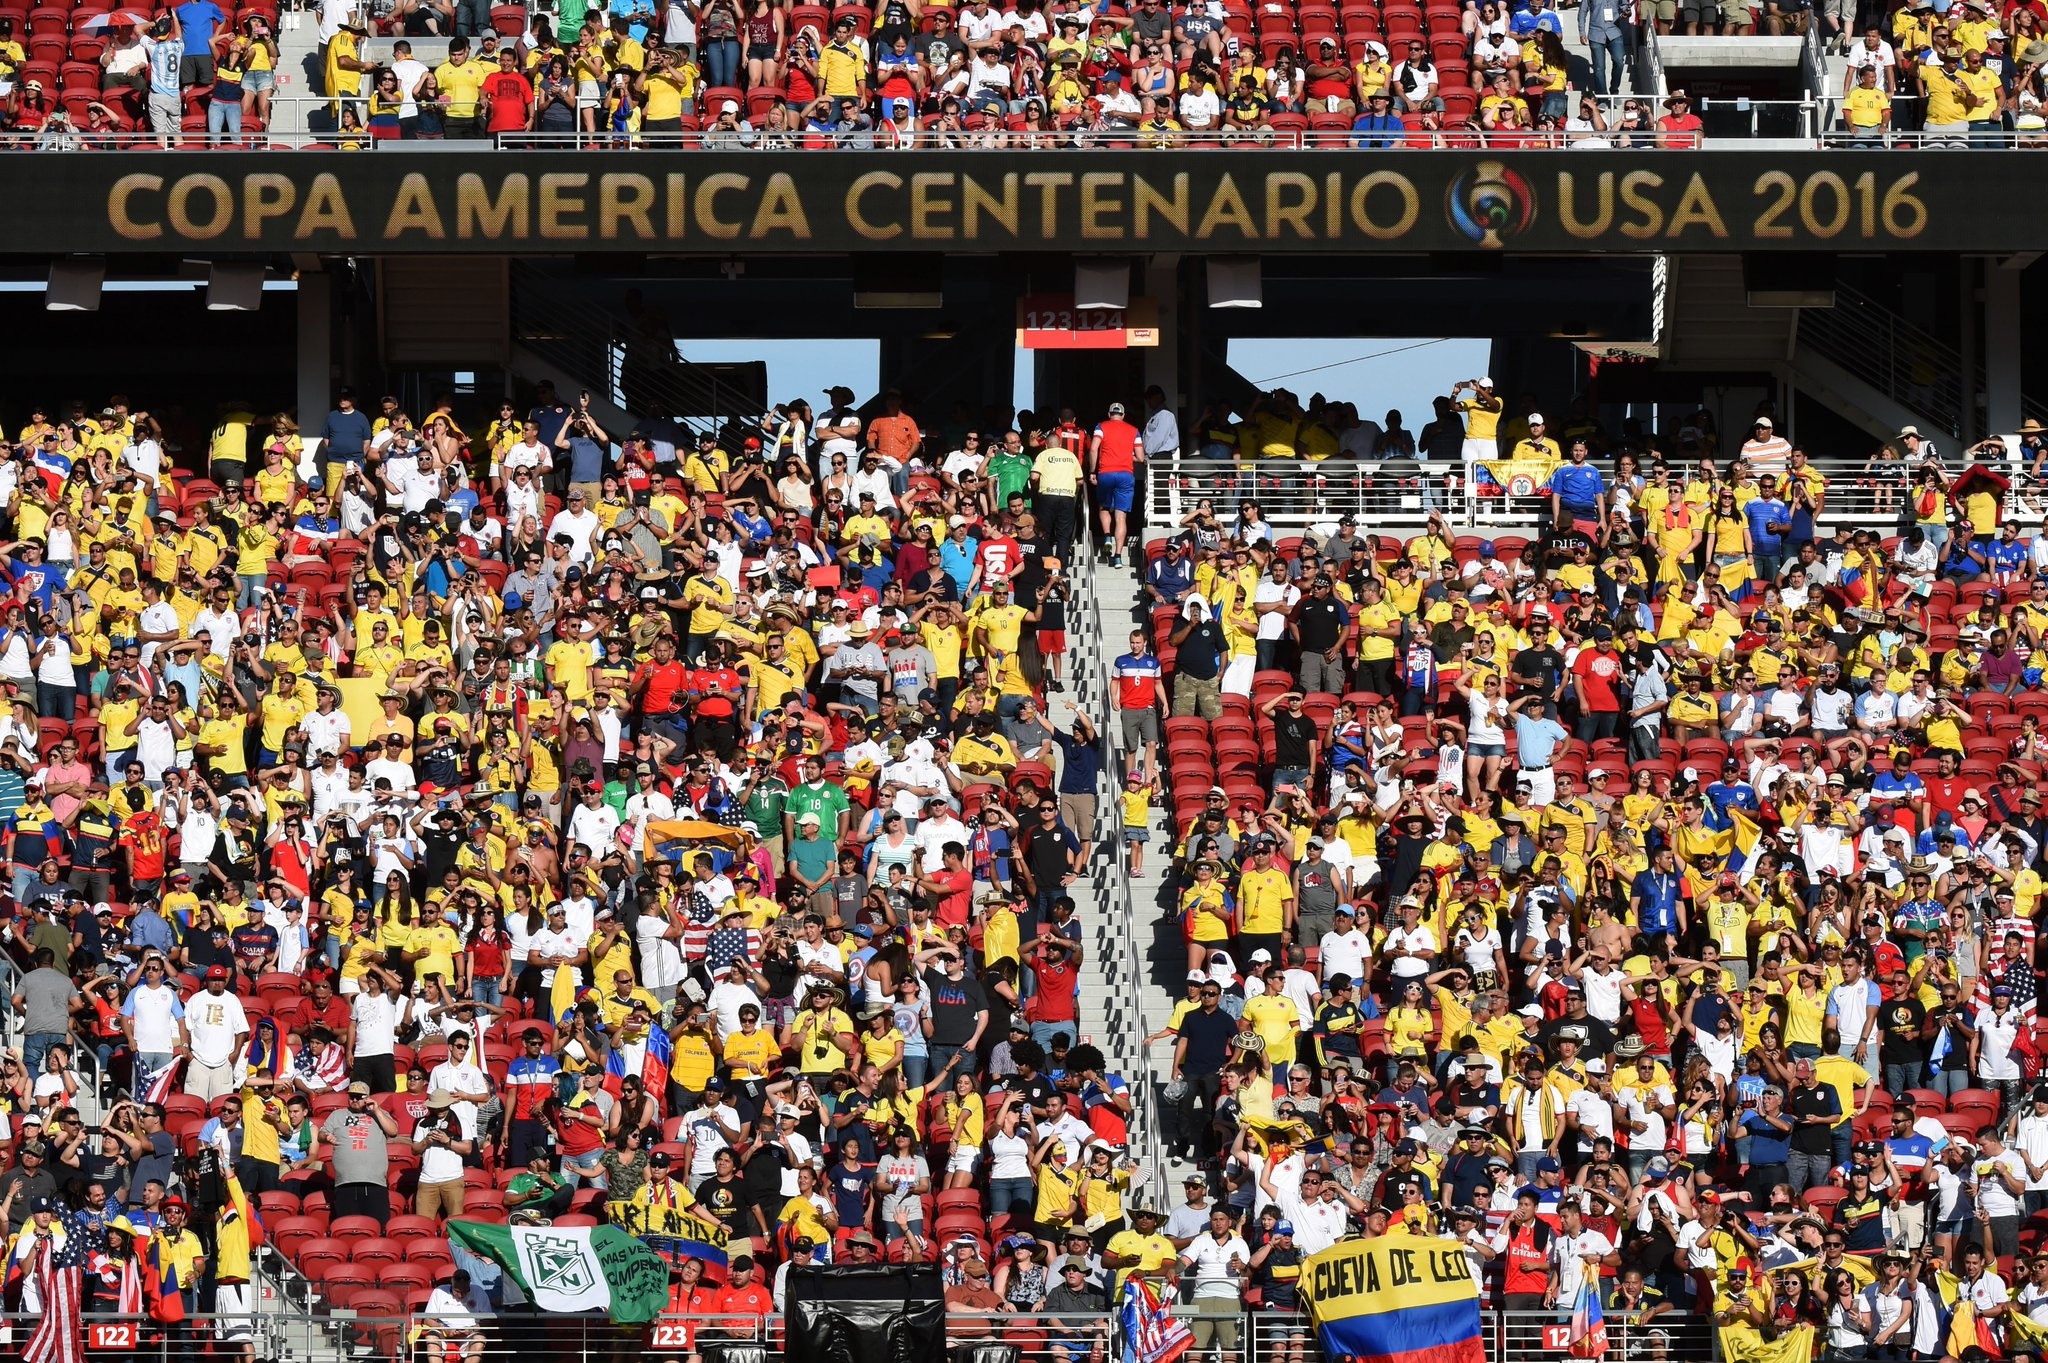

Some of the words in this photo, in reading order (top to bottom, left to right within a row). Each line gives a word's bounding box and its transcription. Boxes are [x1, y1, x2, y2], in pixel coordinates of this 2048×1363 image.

[1186, 20, 1211, 33] USA
[168, 54, 177, 72] 8
[1867, 101, 1874, 109] 10
[107, 172, 357, 240] COPA
[383, 172, 812, 240] AMERICA
[845, 170, 1420, 241] CENTENARIO
[1558, 170, 1729, 240] USA
[1753, 170, 1928, 240] 2016
[1026, 311, 1072, 331] 123
[1078, 311, 1124, 331] 124
[1048, 456, 1074, 464] Corona
[984, 543, 1007, 586] USA
[999, 619, 1007, 630] 10
[938, 637, 943, 645] 9
[1591, 660, 1616, 672] NIKE
[1134, 676, 1141, 686] 6
[1872, 710, 1883, 719] 20
[325, 783, 332, 793] 4
[935, 778, 941, 788] 8
[761, 798, 769, 809] 14
[811, 798, 821, 810] 18
[197, 817, 205, 827] 10
[141, 830, 161, 857] 10
[242, 946, 266, 954] QATAR
[938, 985, 966, 1005] USA
[704, 1129, 716, 1142] 10
[594, 1238, 614, 1253] EL
[1521, 1243, 1530, 1251] Fly
[601, 1248, 627, 1267] MAS
[1512, 1246, 1541, 1259] Emirates
[1313, 1251, 1380, 1302] CUEVA
[1388, 1249, 1420, 1286] DE
[96, 1326, 130, 1346] 122
[650, 1326, 687, 1345] 123
[1549, 1327, 1571, 1347] 12
